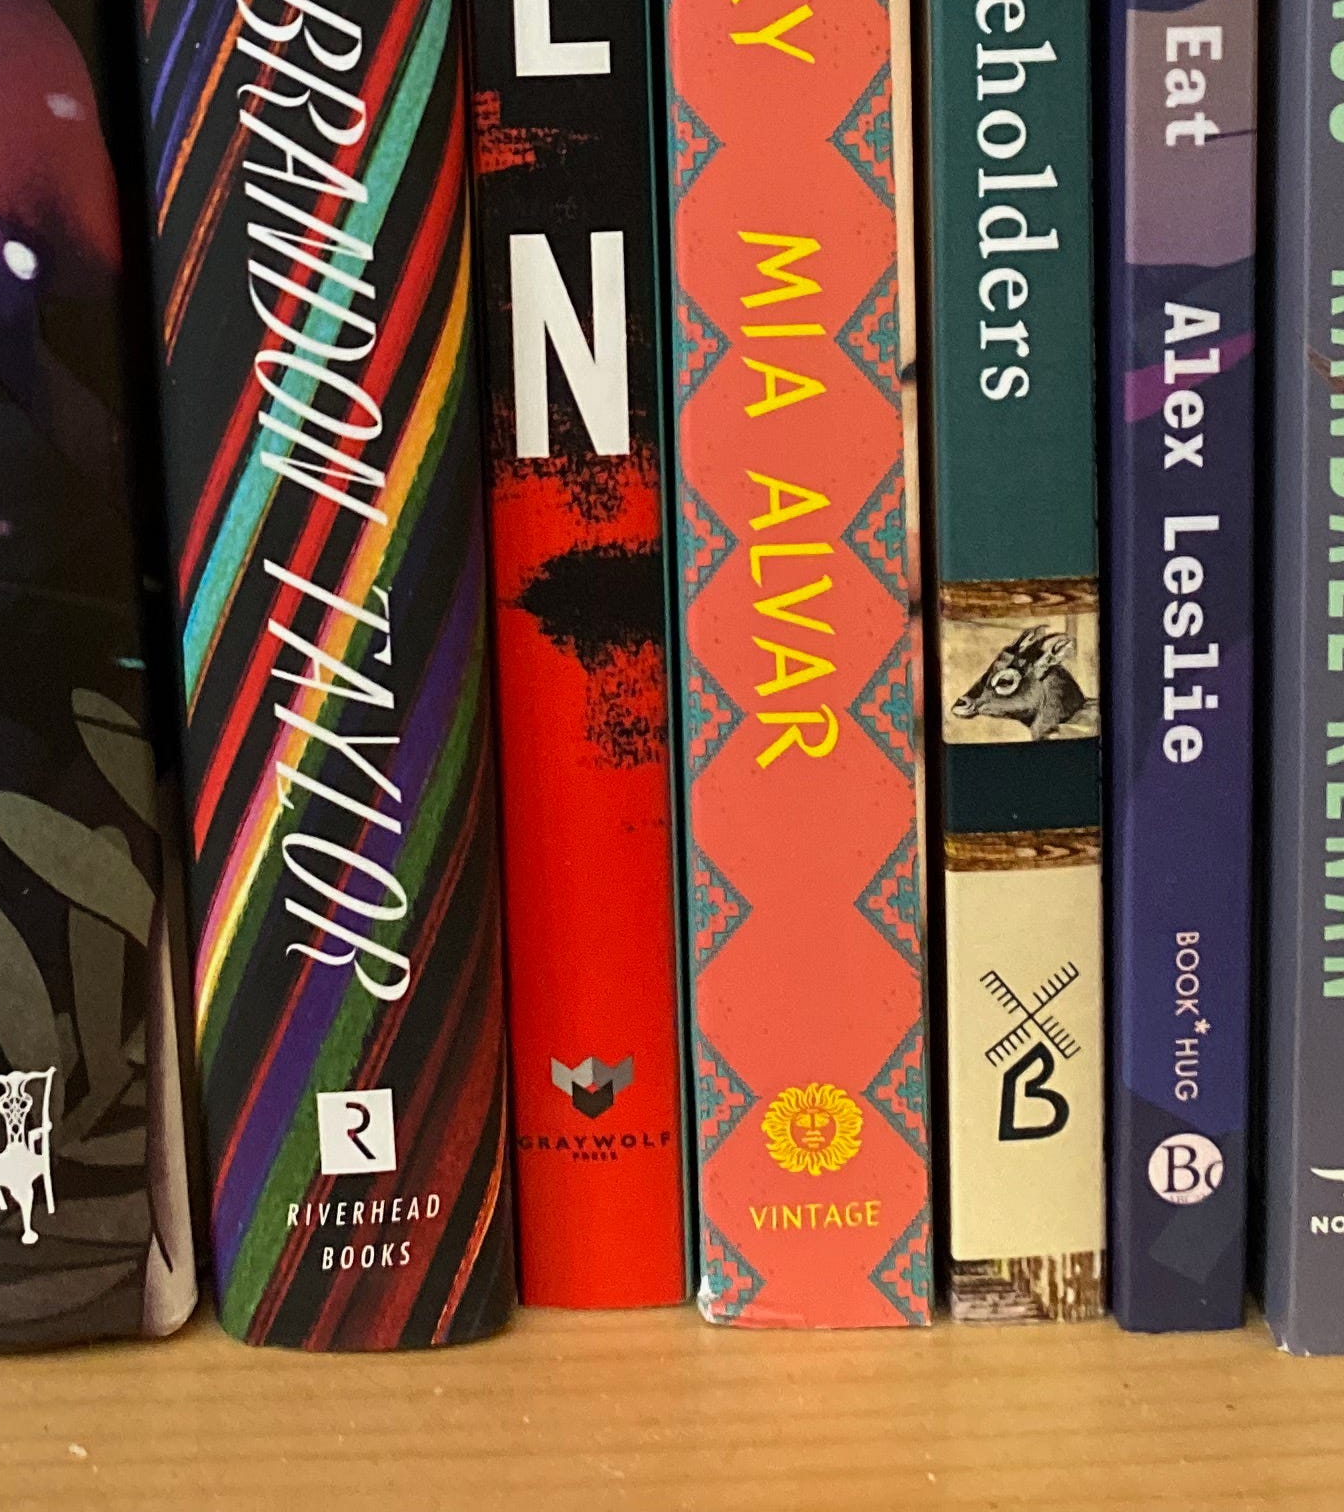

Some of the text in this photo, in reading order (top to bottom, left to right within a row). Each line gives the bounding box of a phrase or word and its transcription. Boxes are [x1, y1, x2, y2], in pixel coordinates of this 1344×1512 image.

[1163, 25, 1223, 148] Eat
[737, 230, 828, 419] MIA
[1163, 301, 1222, 470] Alex
[745, 469, 840, 770] ALVAR
[1162, 514, 1221, 764] Leslie
[263, 558, 412, 1003] TAYLOR
[346, 1102, 376, 1160] R
[517, 1131, 672, 1152] GRAYWOLF
[287, 1194, 440, 1227] RIVERHEAD
[322, 1241, 411, 1270] BOOKS
[749, 1200, 882, 1231] VINTAGE
